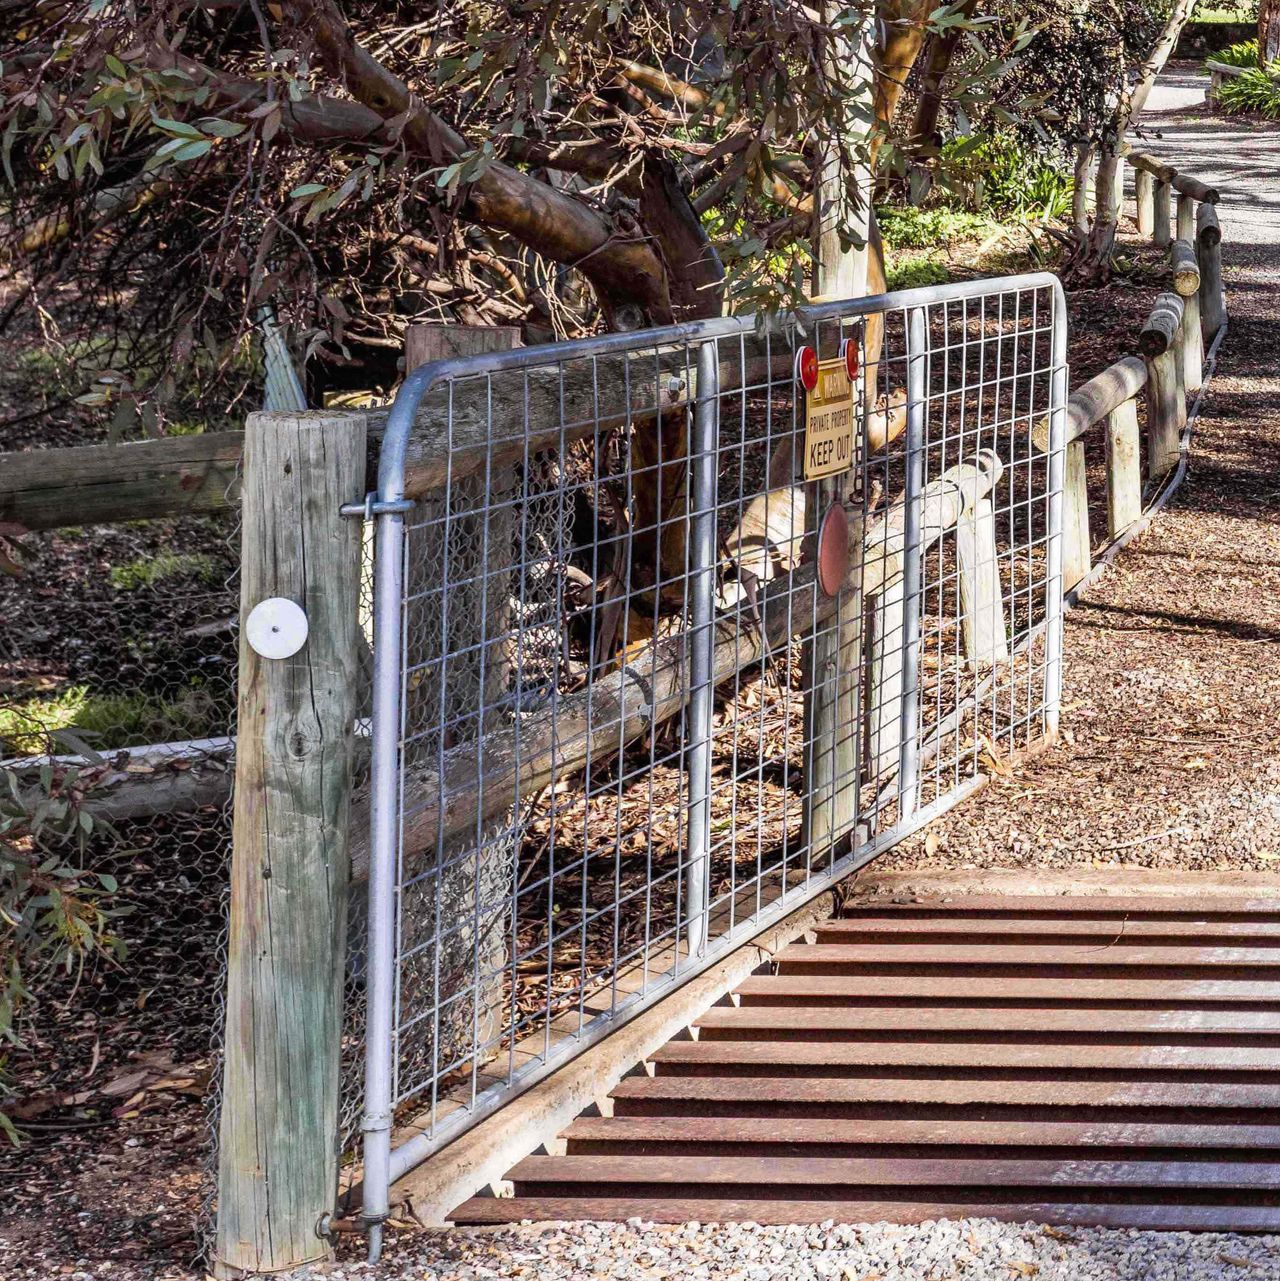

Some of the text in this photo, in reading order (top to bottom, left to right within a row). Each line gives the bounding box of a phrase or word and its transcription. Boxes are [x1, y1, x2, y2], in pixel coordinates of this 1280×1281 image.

[810, 413, 829, 434] PRIVATE
[810, 434, 850, 468] KEEP OUT
